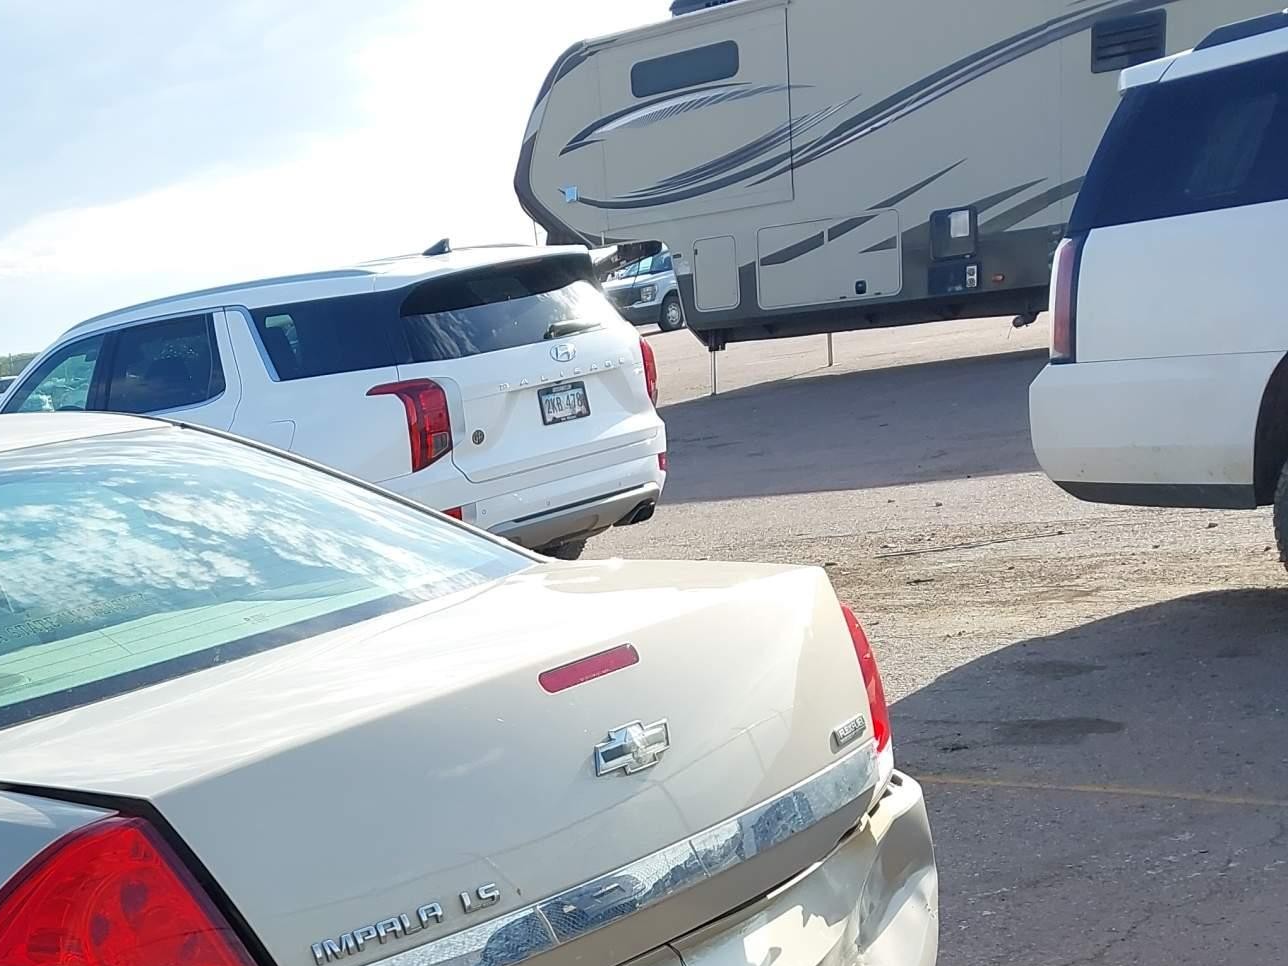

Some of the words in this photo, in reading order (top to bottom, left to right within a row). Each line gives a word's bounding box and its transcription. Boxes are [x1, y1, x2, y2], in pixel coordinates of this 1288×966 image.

[6, 615, 61, 639] STATE
[311, 902, 443, 966] IMPALA
[459, 883, 501, 914] LS
